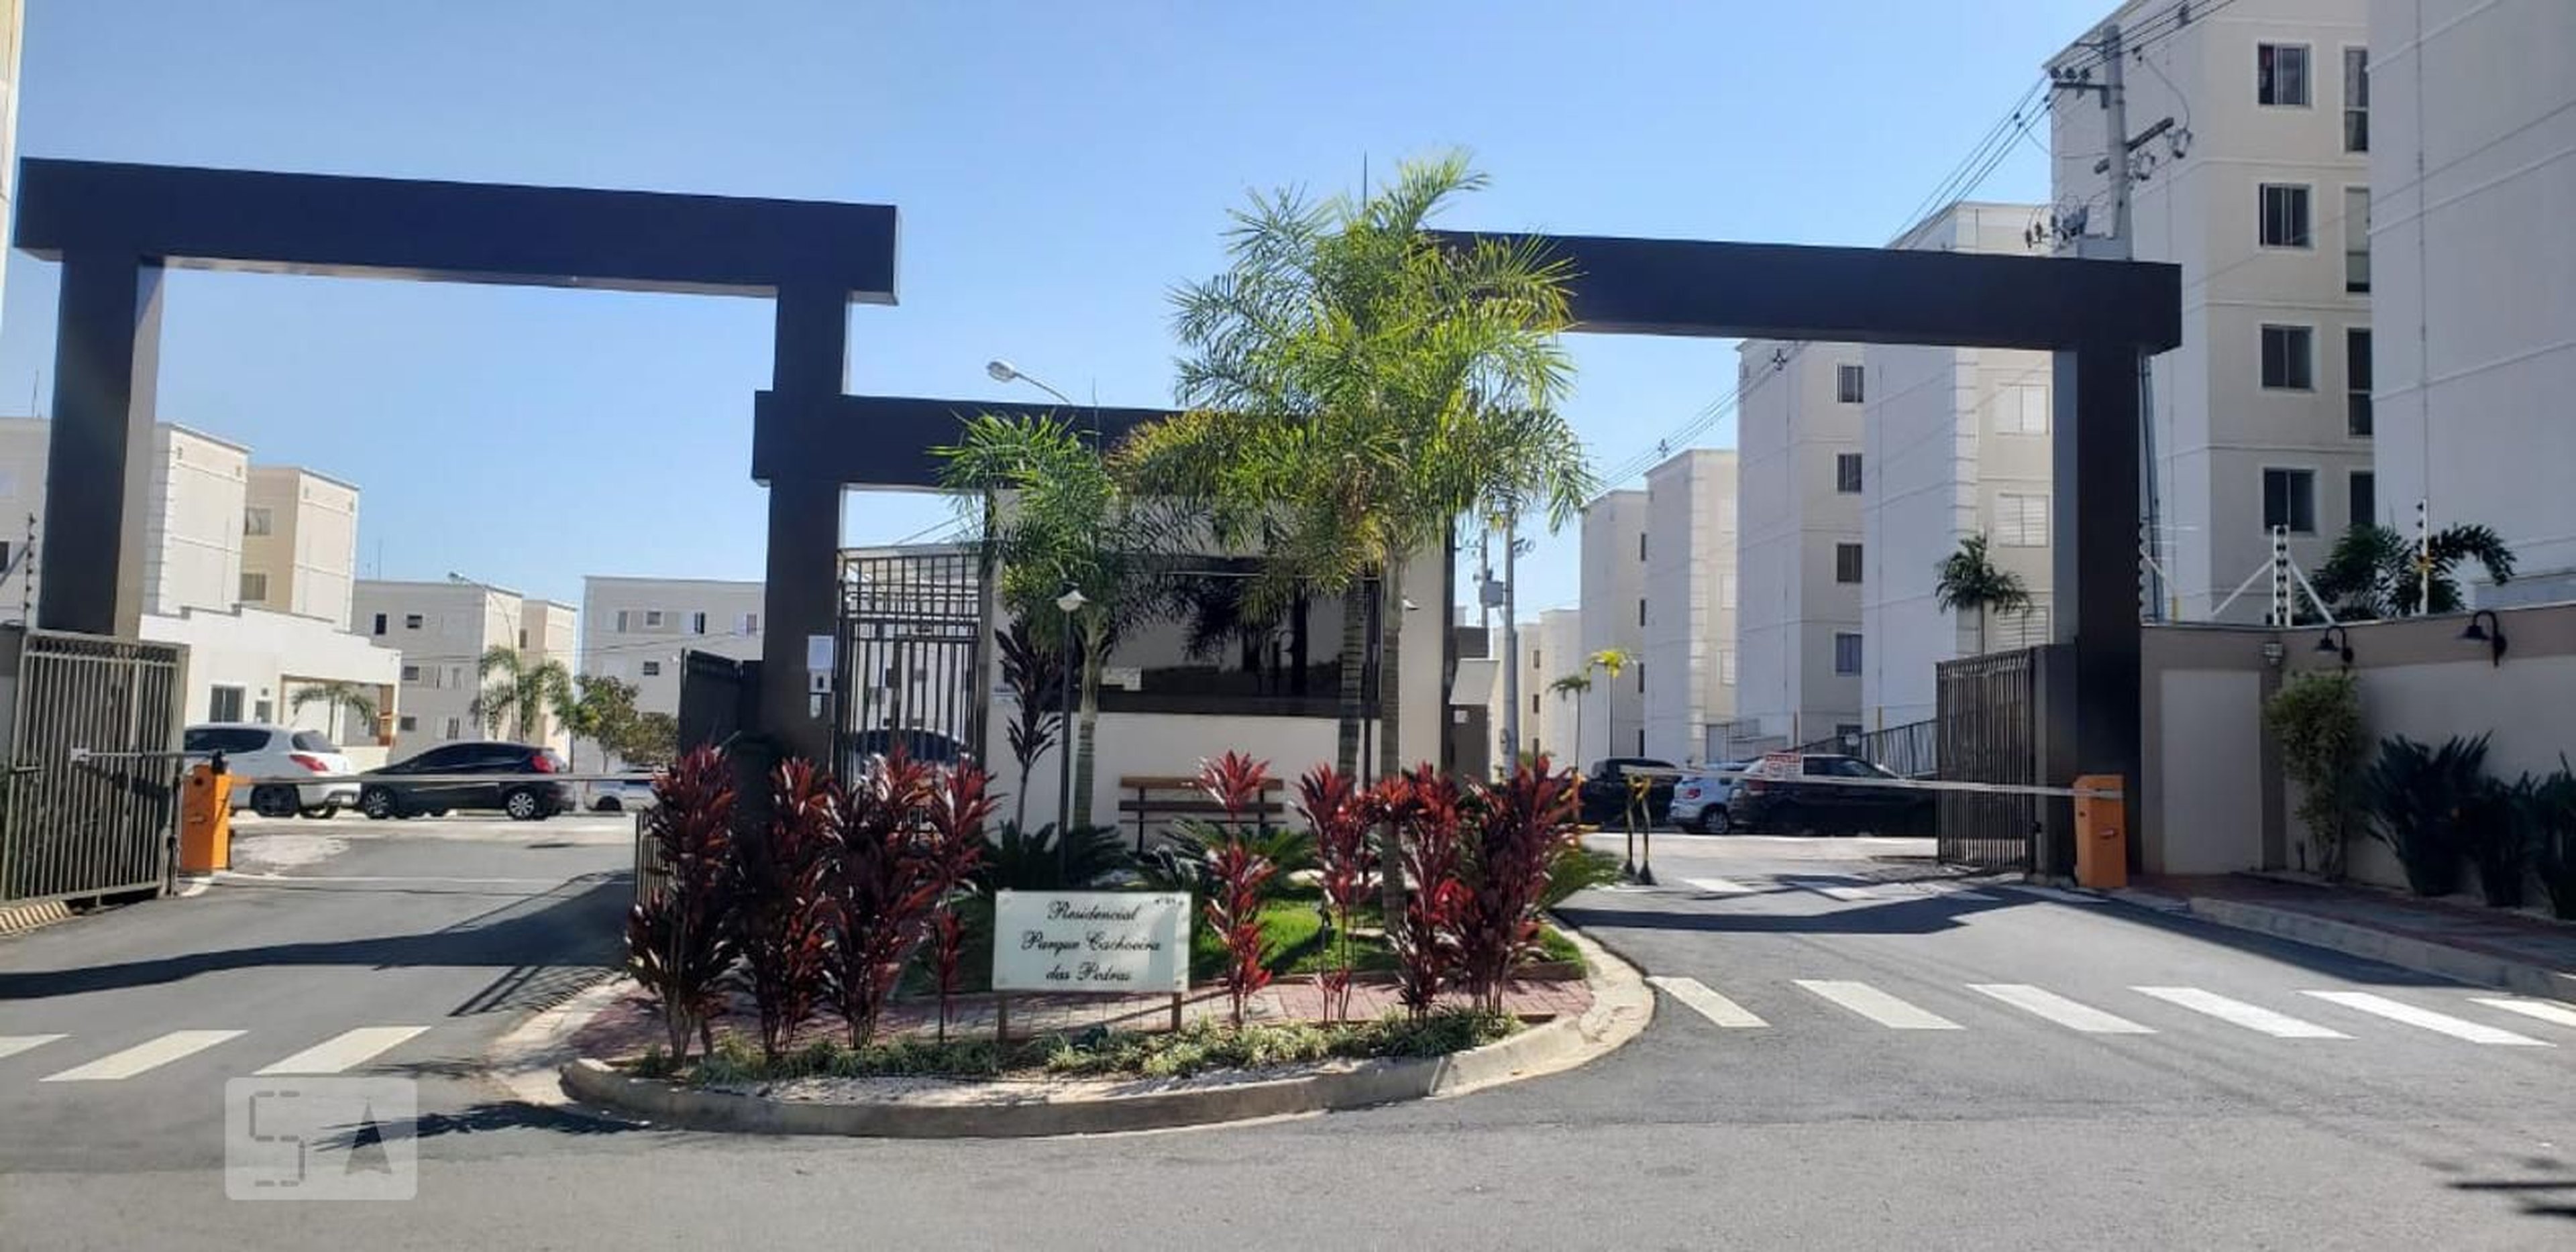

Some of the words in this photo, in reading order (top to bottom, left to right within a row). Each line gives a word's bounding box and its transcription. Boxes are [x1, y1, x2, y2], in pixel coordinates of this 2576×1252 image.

[1047, 901, 1140, 920] Residencial
[1021, 931, 1080, 957] Parque
[1086, 930, 1161, 951] Cachoeira
[1046, 964, 1070, 980] das
[1076, 962, 1131, 981] Pedras
